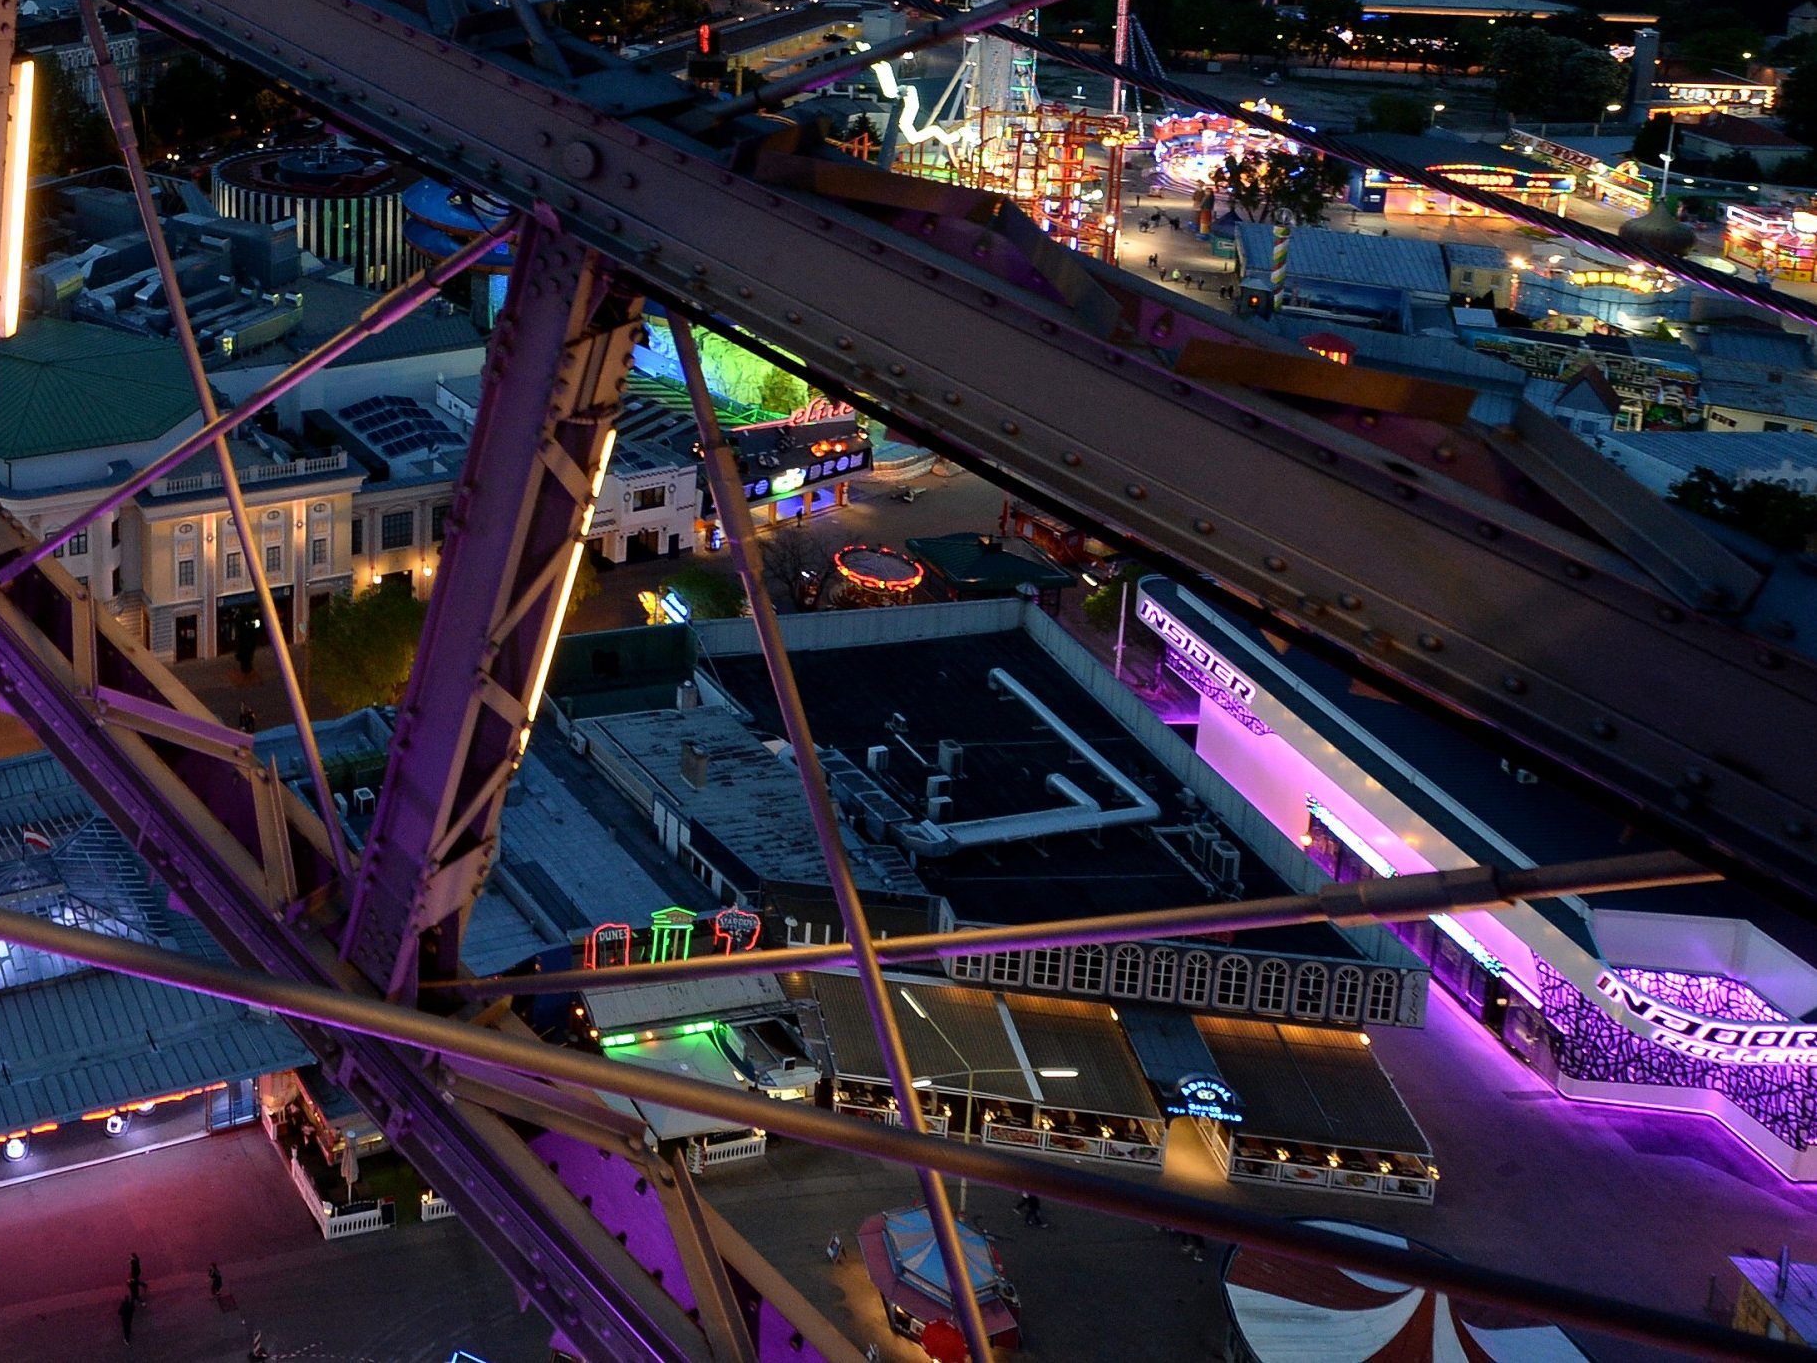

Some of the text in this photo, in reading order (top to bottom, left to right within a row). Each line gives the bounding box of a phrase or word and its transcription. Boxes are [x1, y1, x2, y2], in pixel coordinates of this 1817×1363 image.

[809, 452, 864, 481] DROM
[1141, 599, 1257, 706] INSIDER
[1597, 971, 1817, 1049] INDOOR
